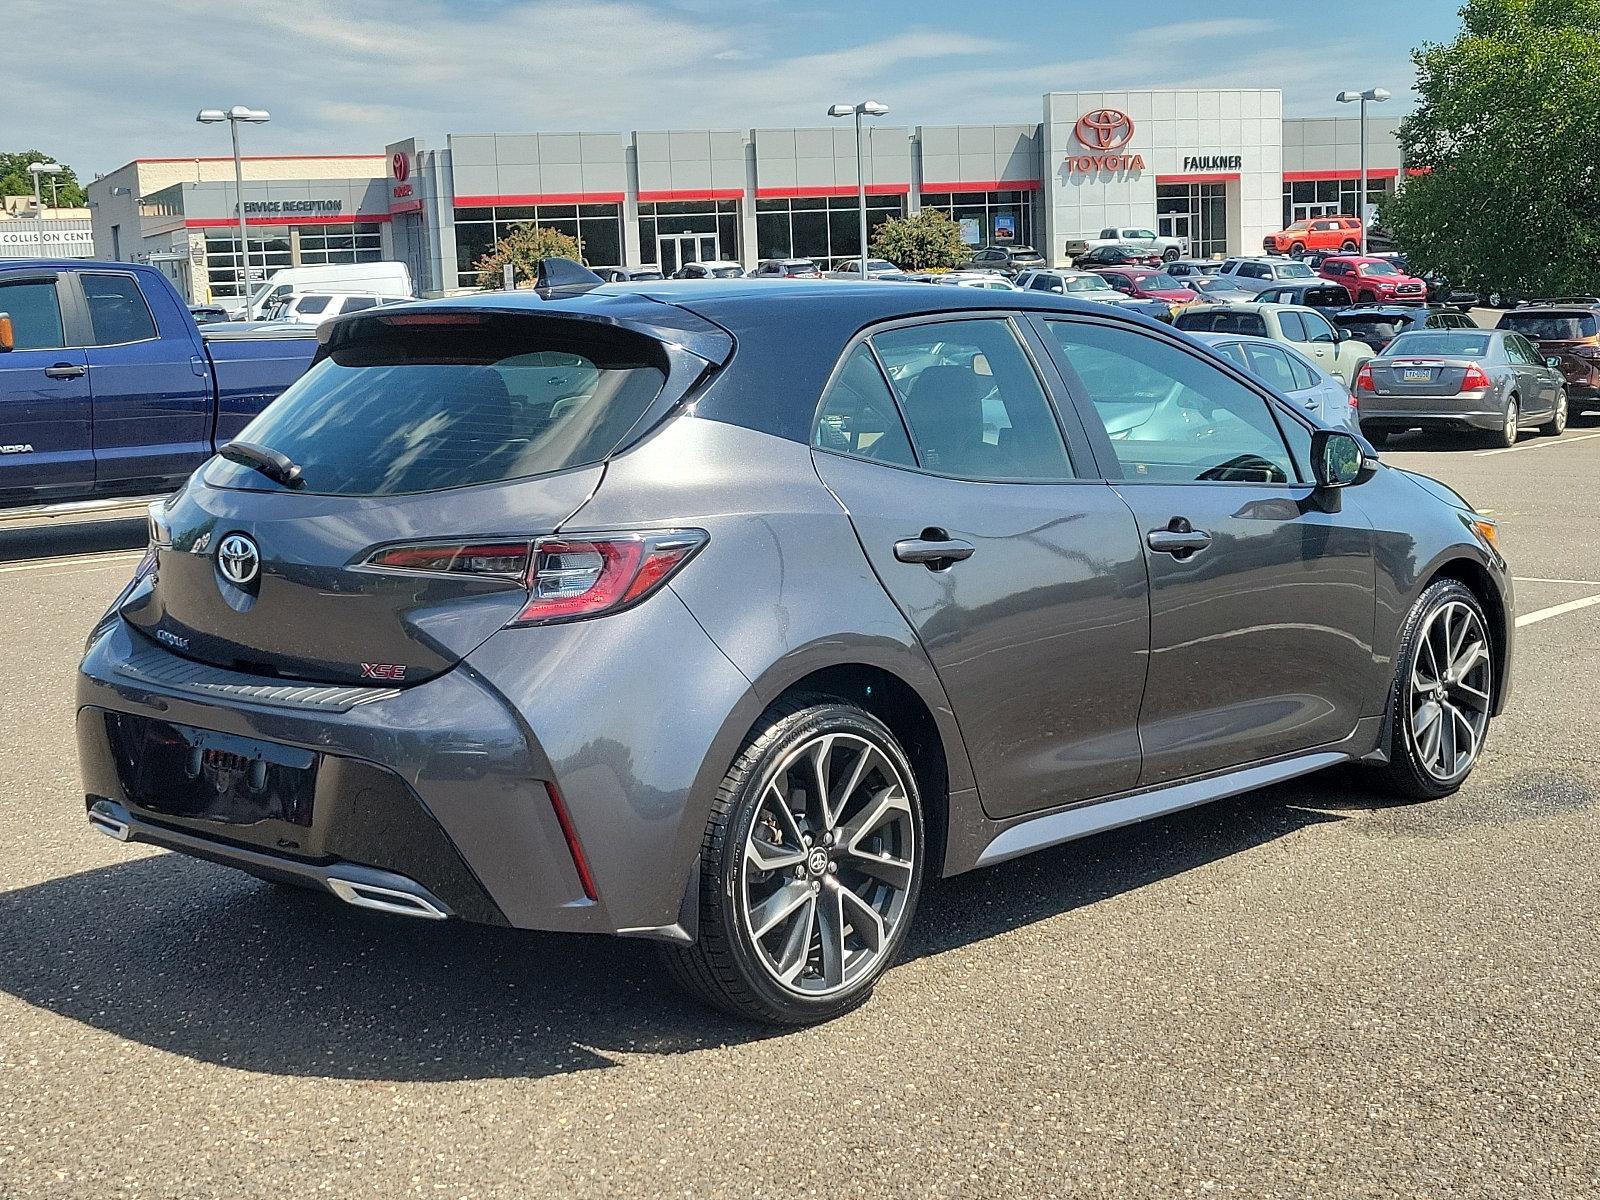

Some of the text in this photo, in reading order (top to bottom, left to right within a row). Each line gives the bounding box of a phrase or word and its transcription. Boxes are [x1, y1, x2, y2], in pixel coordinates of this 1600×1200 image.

[1065, 154, 1145, 173] TOYOTA
[1183, 155, 1242, 171] FAULKNER
[282, 199, 342, 212] RECEPTION
[3, 233, 60, 243] COLLISON
[360, 662, 407, 680] XSE
